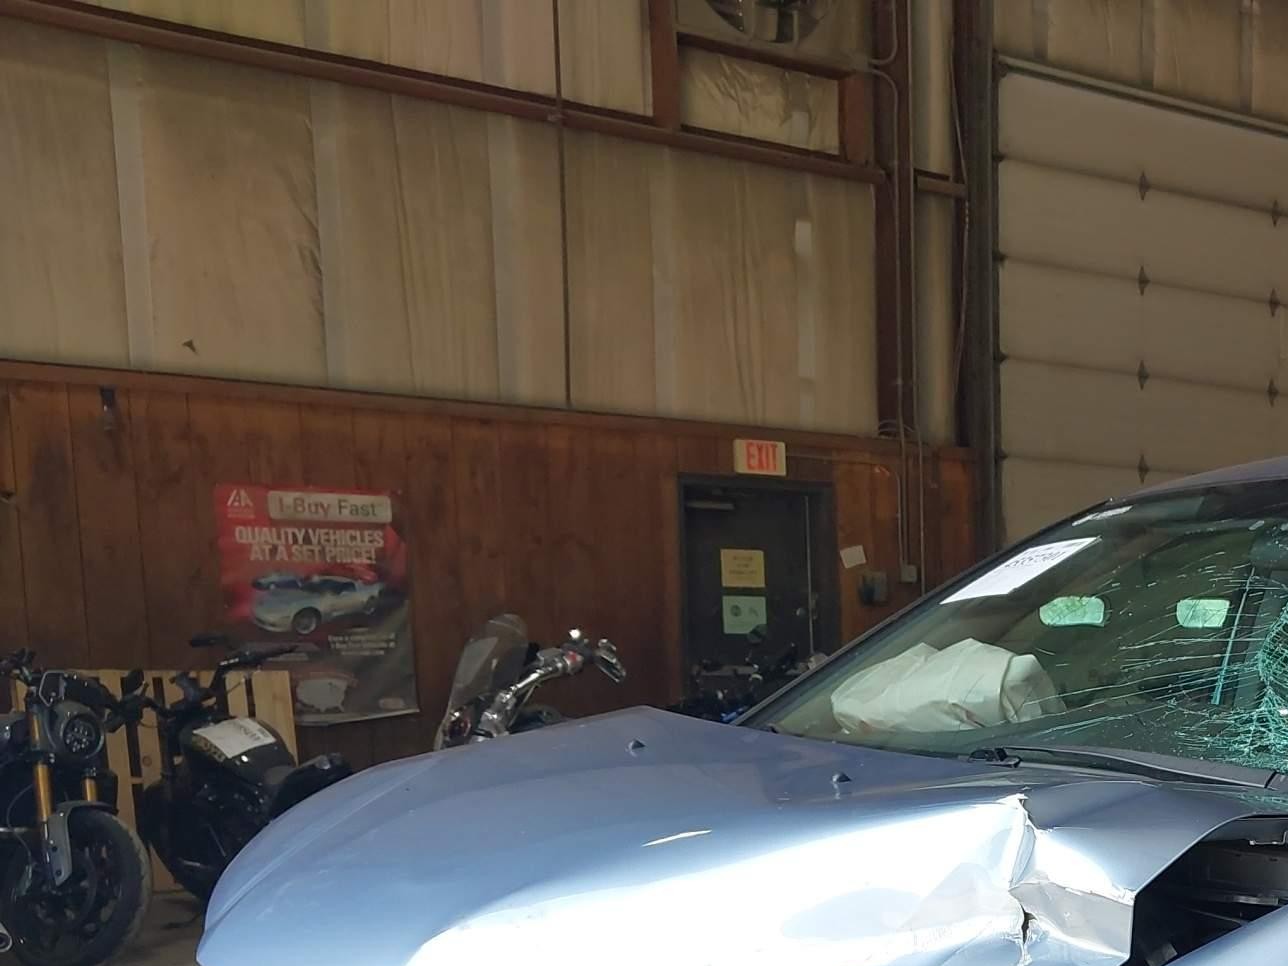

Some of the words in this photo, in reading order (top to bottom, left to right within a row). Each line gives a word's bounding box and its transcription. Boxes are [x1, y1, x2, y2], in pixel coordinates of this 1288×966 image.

[745, 441, 779, 472] EXIT
[337, 498, 378, 518] Fast
[235, 526, 305, 545] QUALITY
[307, 528, 384, 547] VEHICLES
[249, 544, 274, 561] AT
[275, 545, 288, 561] A
[291, 545, 322, 562] SET
[325, 547, 376, 565] PRICE!
